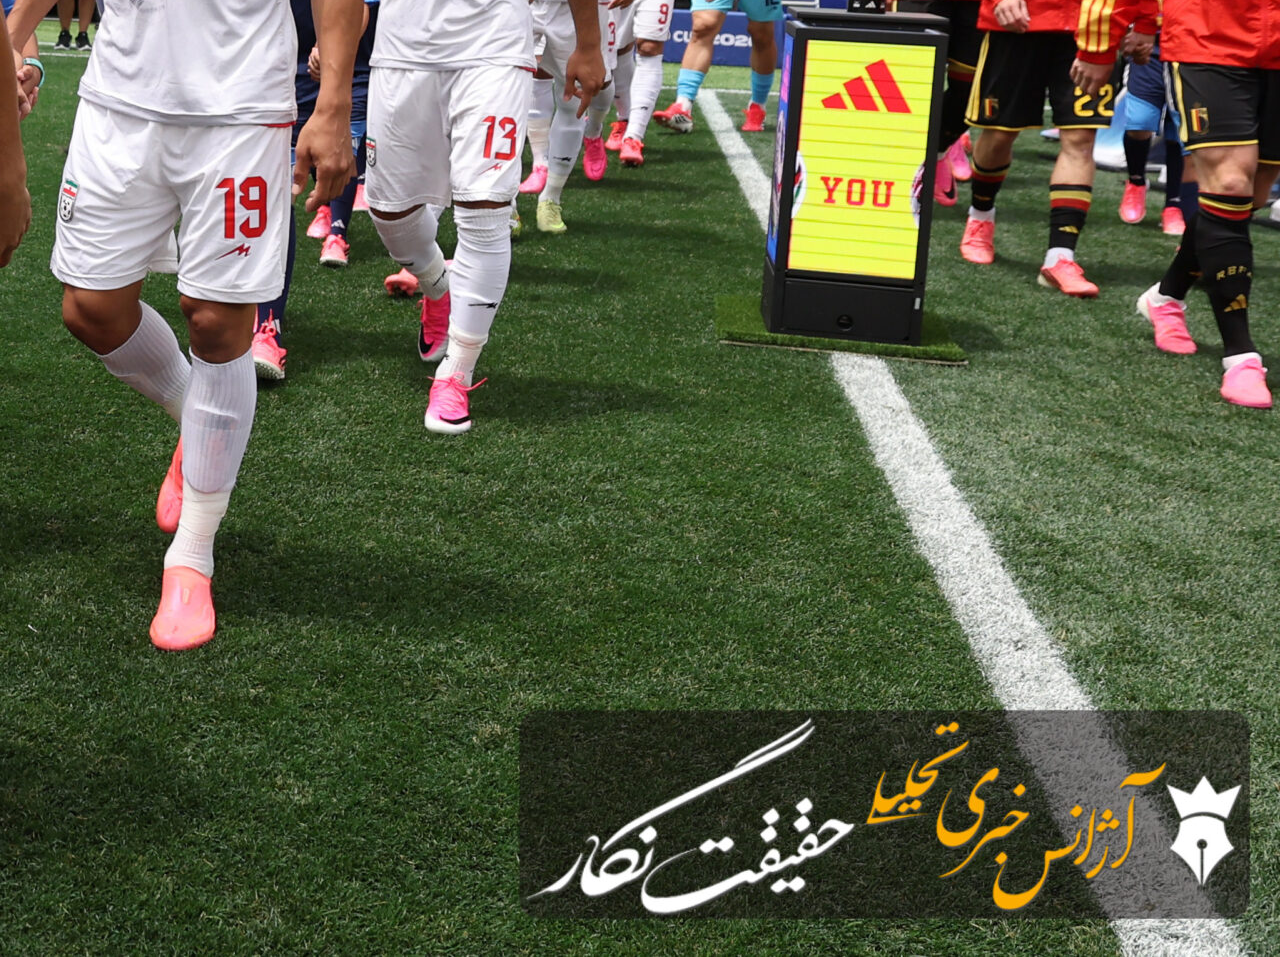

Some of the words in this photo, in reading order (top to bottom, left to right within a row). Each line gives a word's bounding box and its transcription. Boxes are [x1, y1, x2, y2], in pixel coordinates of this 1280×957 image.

[657, 3, 669, 25] 9
[1073, 83, 1115, 117] 22
[481, 115, 517, 161] 13
[216, 176, 268, 239] 19
[819, 175, 895, 209] YOU
